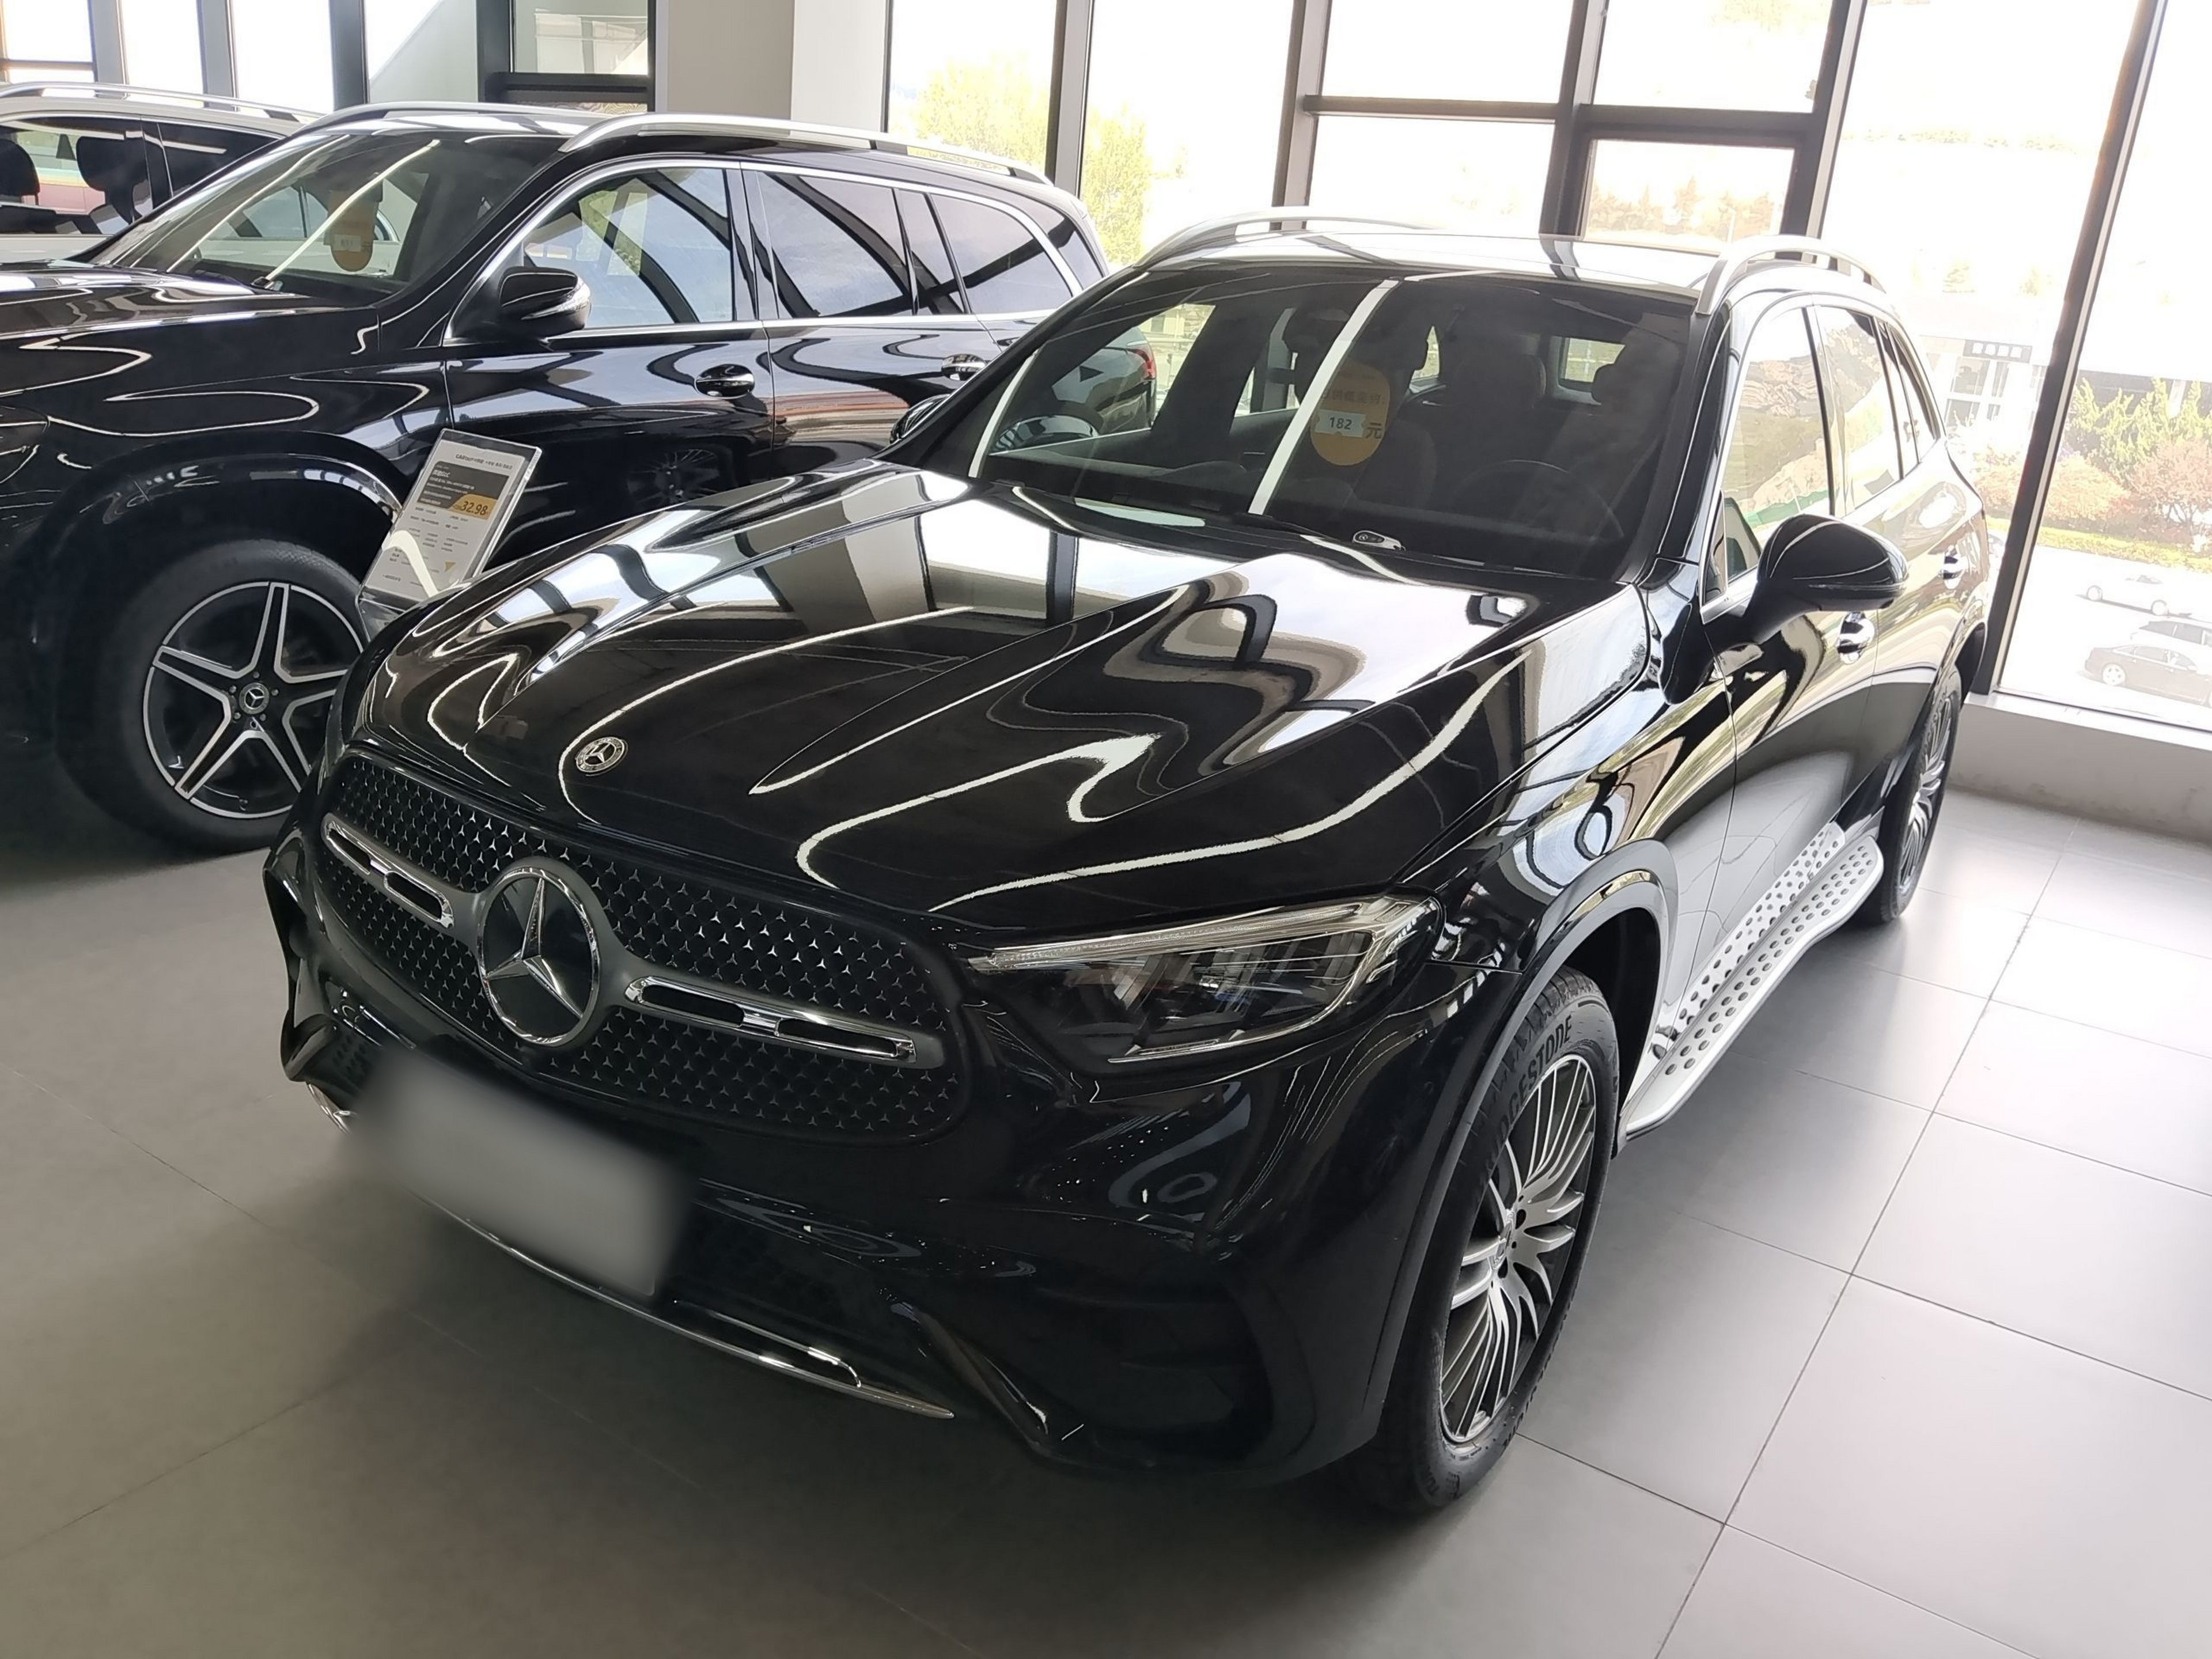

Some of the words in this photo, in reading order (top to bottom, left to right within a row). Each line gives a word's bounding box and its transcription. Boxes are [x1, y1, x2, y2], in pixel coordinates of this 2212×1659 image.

[1330, 416, 1353, 430] 182
[1365, 421, 1382, 440] 元
[461, 500, 488, 516] 32.98
